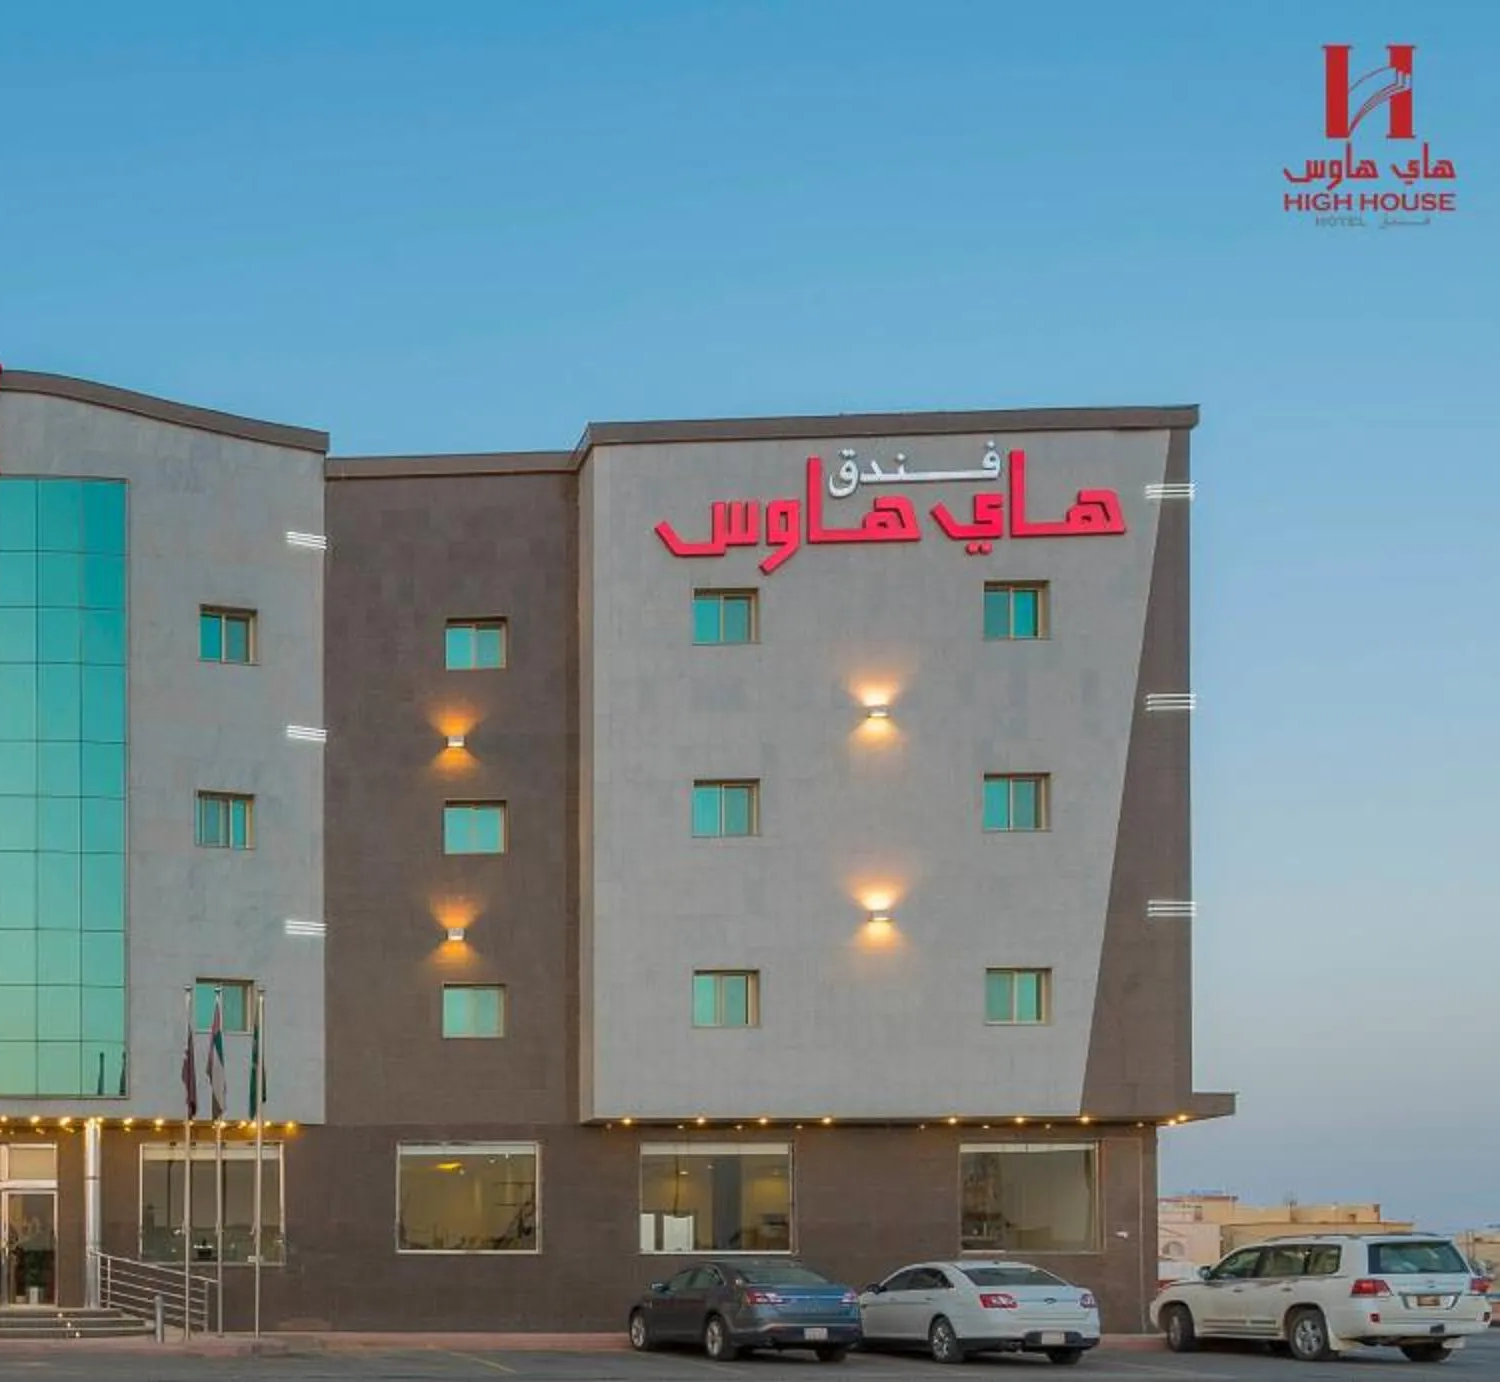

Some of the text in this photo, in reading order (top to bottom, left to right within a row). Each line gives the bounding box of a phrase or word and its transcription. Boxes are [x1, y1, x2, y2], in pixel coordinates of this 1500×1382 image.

[654, 449, 1127, 576] هاي هاوس
[828, 440, 1001, 498] فندق
